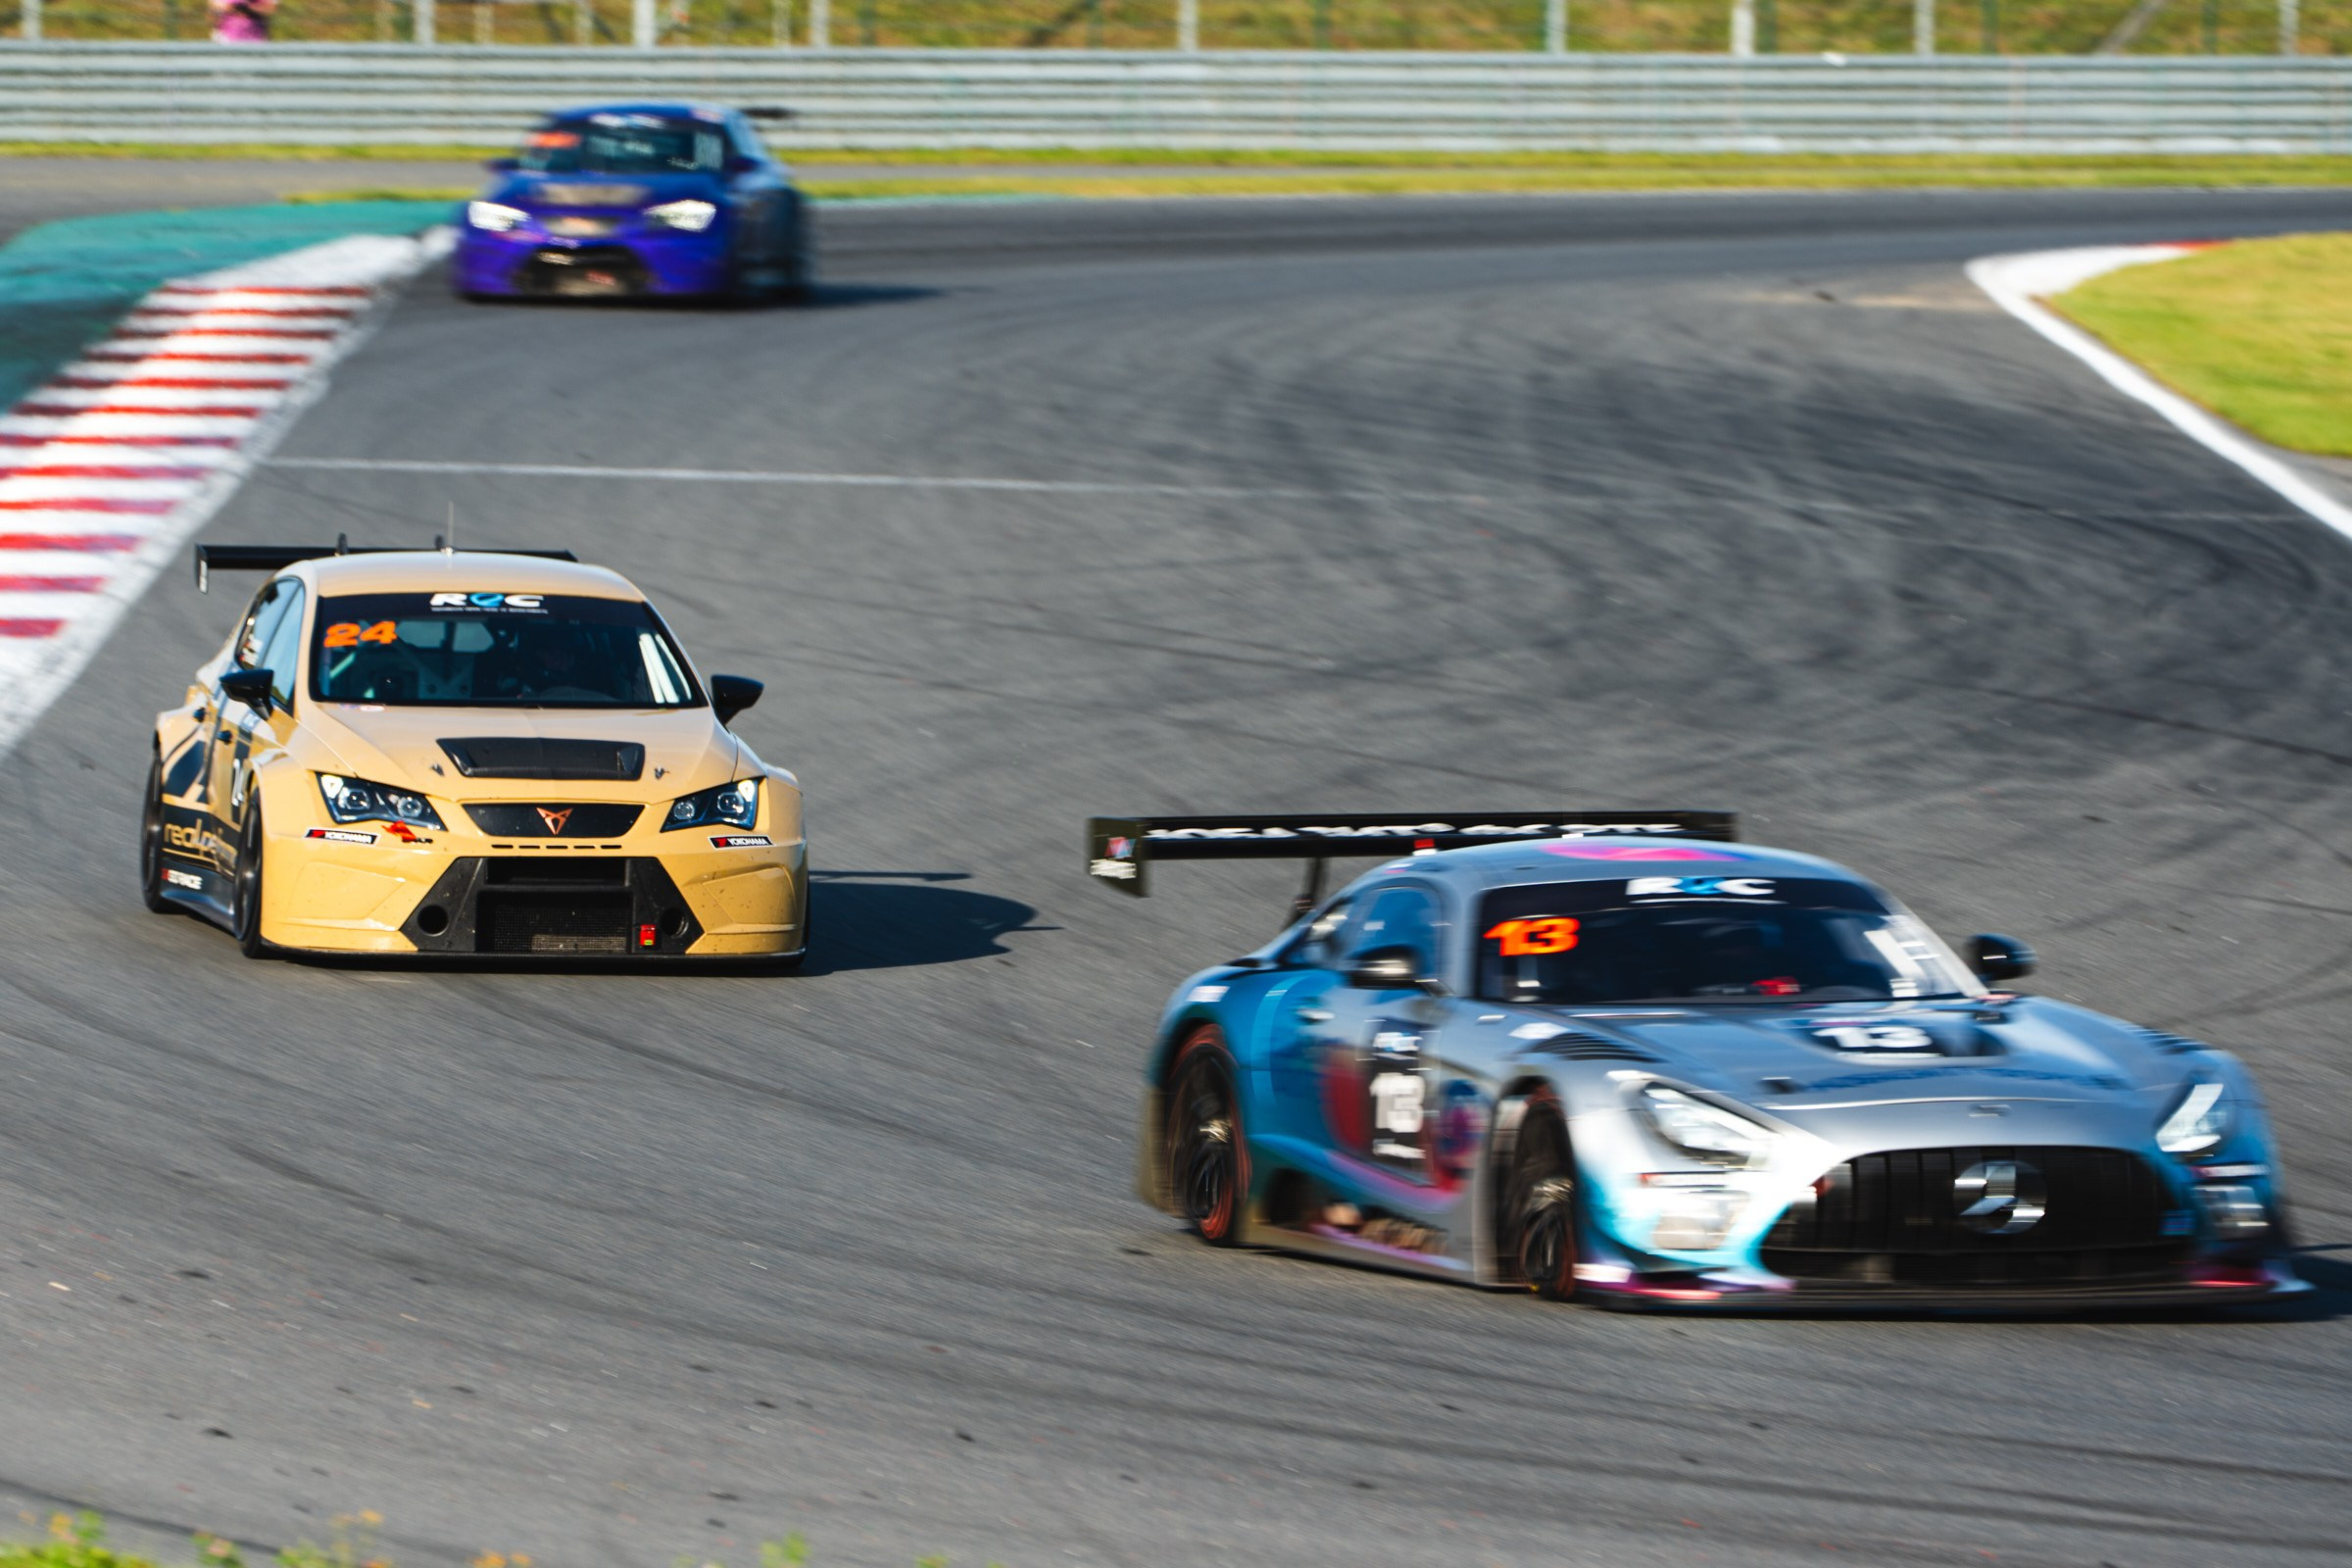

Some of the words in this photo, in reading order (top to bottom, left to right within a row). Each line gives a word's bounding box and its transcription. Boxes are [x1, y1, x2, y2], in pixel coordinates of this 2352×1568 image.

[323, 620, 397, 648] 24
[1483, 917, 1580, 956] 13
[1812, 1026, 1933, 1049] 13
[1369, 1072, 1426, 1133] 13
